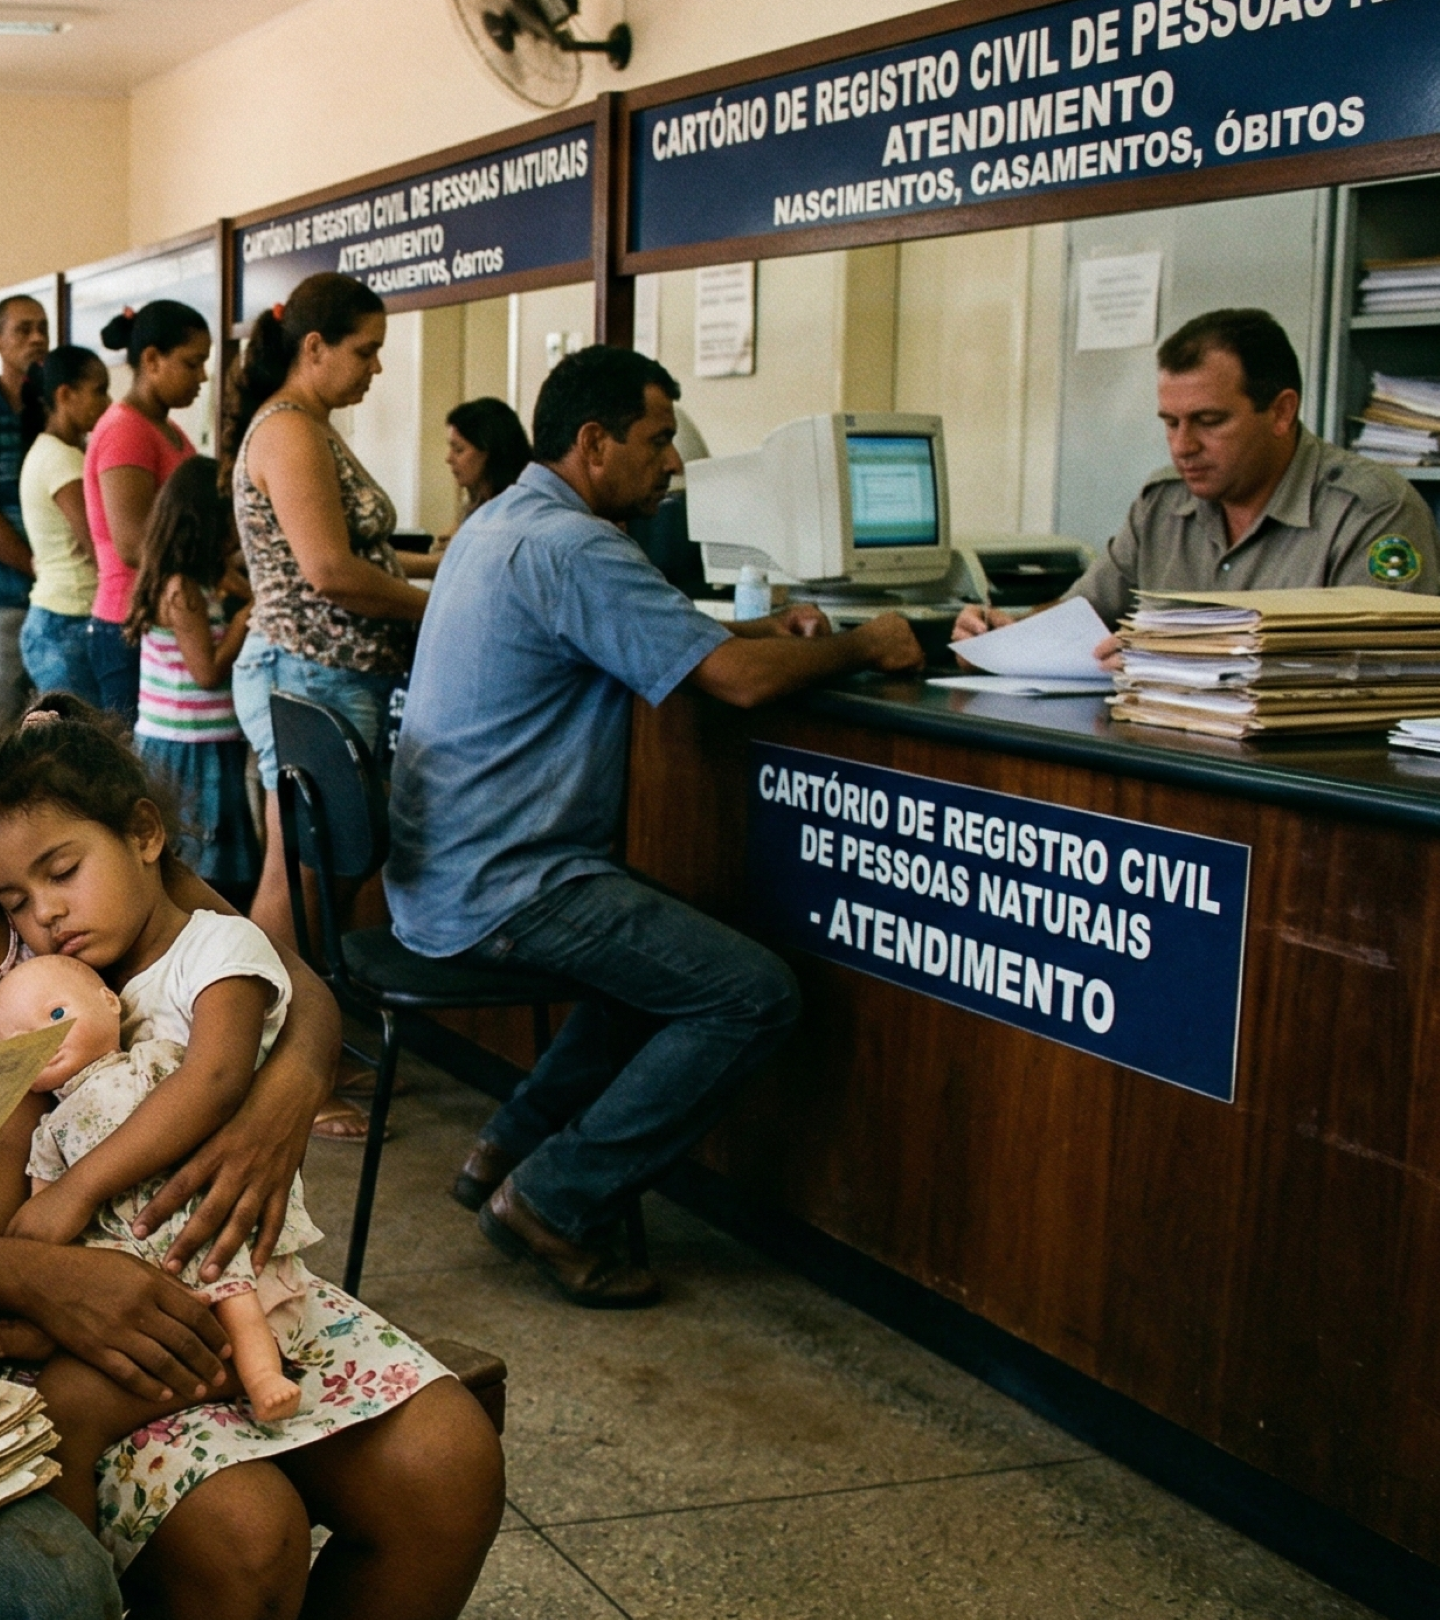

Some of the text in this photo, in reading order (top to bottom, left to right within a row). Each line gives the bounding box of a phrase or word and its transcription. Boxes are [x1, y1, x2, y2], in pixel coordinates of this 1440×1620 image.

[652, 97, 768, 161] CARTÓRIO
[774, 86, 808, 135] DE
[816, 50, 960, 126] REGISTRO
[971, 27, 1059, 91] CIVIL
[1071, 9, 1120, 70] DE
[882, 71, 1174, 167] ATENDIMENTO
[295, 217, 311, 251] DE
[312, 200, 371, 245] REGISTRO
[374, 191, 408, 230] CIVIL
[411, 183, 430, 220] DE
[432, 164, 500, 213] PESSOAS
[502, 138, 588, 196] NATURAIS
[774, 96, 1365, 227] NASCIMENTOS, CASAMENTOS, ÓBITOS
[337, 224, 444, 274] ATENDIMENTO
[452, 246, 504, 279] ÓBITOS
[759, 764, 1221, 915] CARTÓRIO DE REGISTRO CIVIL
[801, 824, 1152, 960] DE PESSOAS NATURAIS
[828, 898, 1115, 1034] ATENDIMENTO
